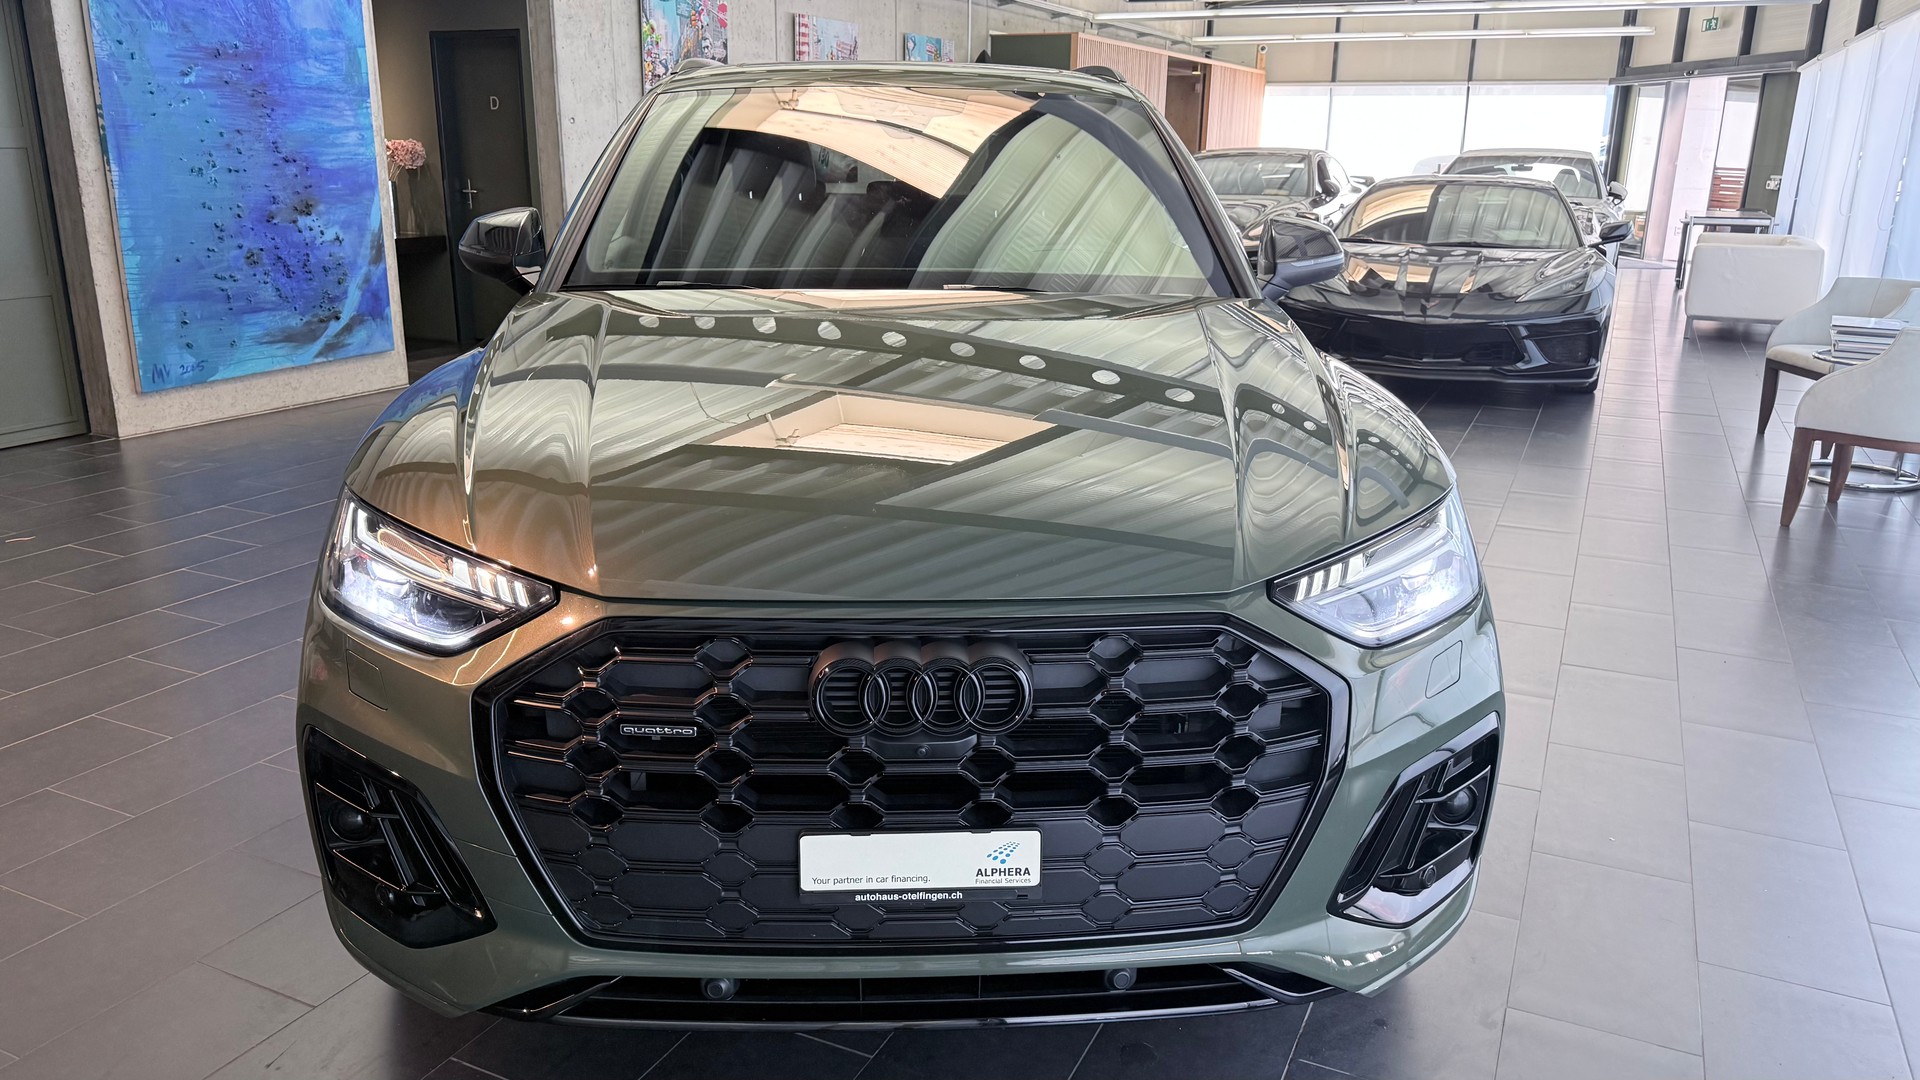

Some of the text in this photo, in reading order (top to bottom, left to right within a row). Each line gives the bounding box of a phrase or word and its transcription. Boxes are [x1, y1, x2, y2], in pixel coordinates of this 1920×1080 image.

[490, 96, 499, 110] D
[623, 727, 693, 735] quattro
[975, 867, 1031, 878] ALPHERA
[812, 874, 931, 886] Your partner in car financing.
[855, 891, 963, 902] autohaus-otelfingen.ch
